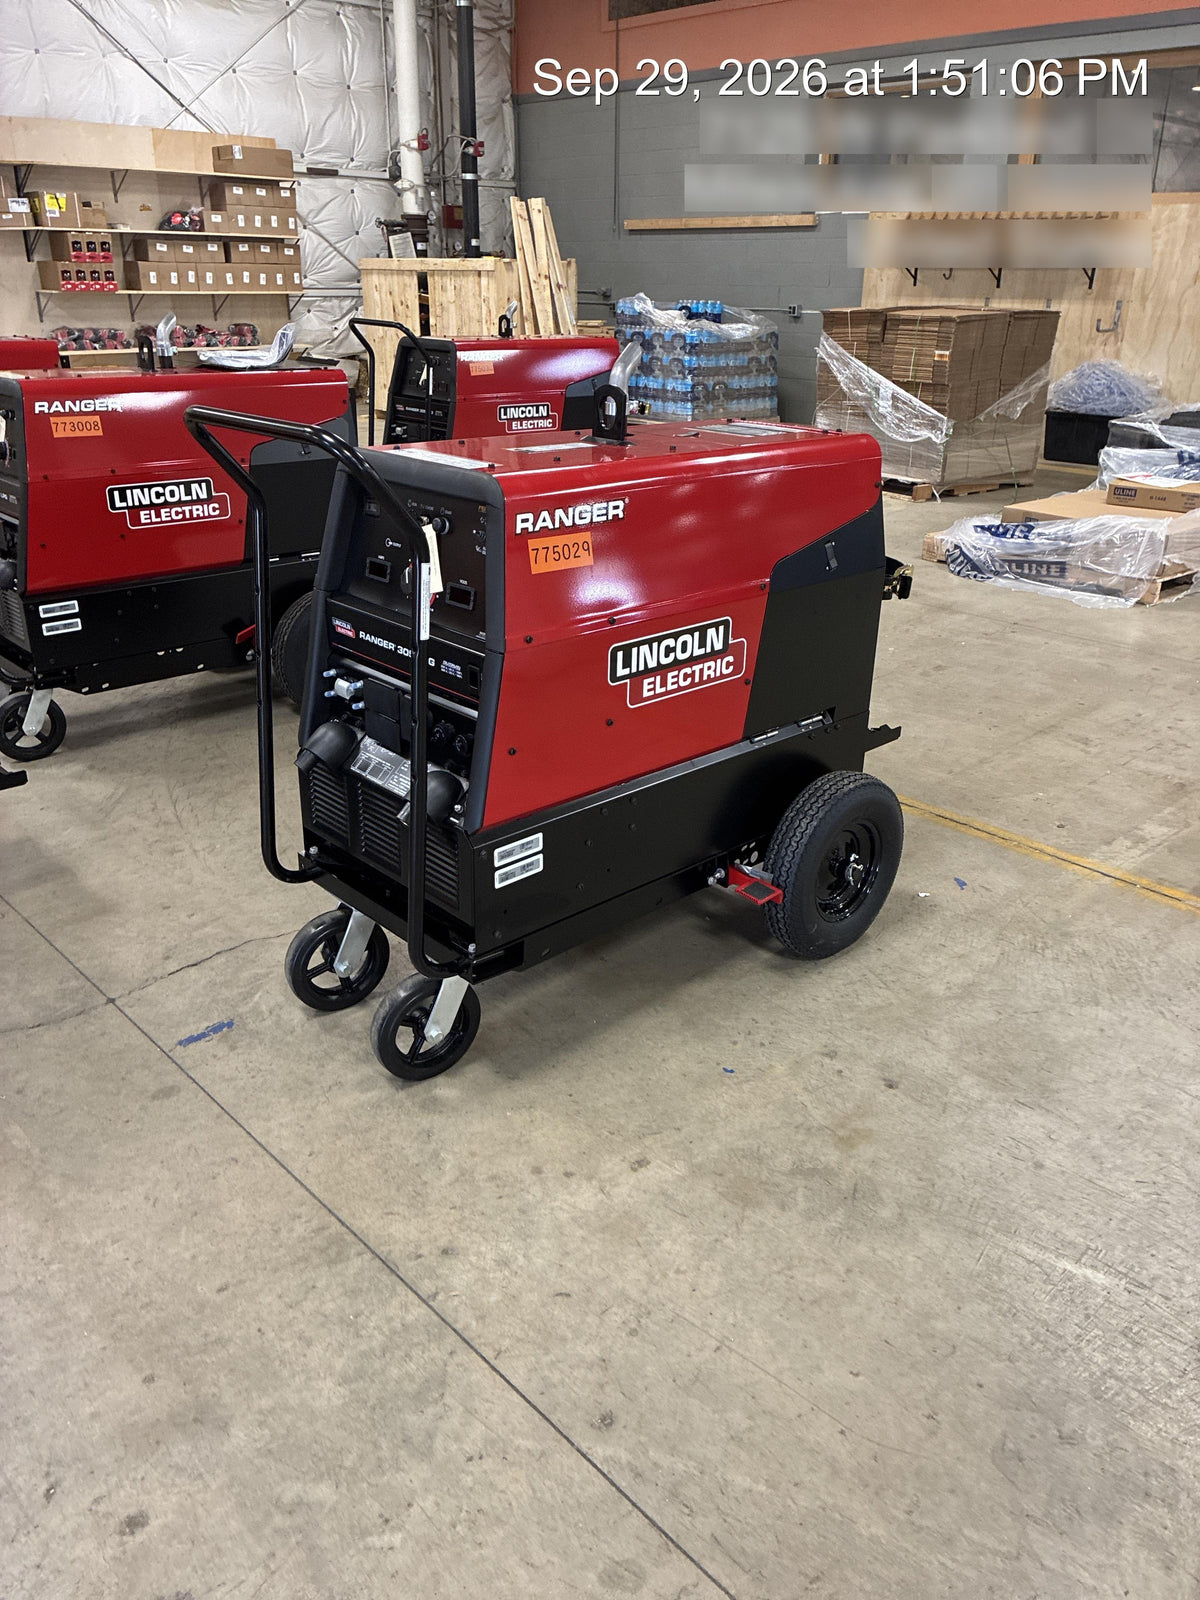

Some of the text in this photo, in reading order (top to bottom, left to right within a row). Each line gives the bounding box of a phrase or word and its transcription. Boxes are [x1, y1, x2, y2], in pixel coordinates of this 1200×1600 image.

[34, 399, 123, 414] RANGER
[500, 405, 548, 420] LINCOLN
[52, 418, 101, 433] 773008
[512, 419, 553, 430] ELECTRIC
[113, 482, 208, 508] LINCOLN
[1114, 488, 1136, 497] ULINE
[140, 503, 220, 523] ELECTRIC
[515, 500, 626, 534] RANGER
[531, 540, 592, 565] 775029
[359, 631, 395, 651] RANGER
[616, 625, 725, 678] LINCOLN
[642, 656, 734, 698] ELECTRIC
